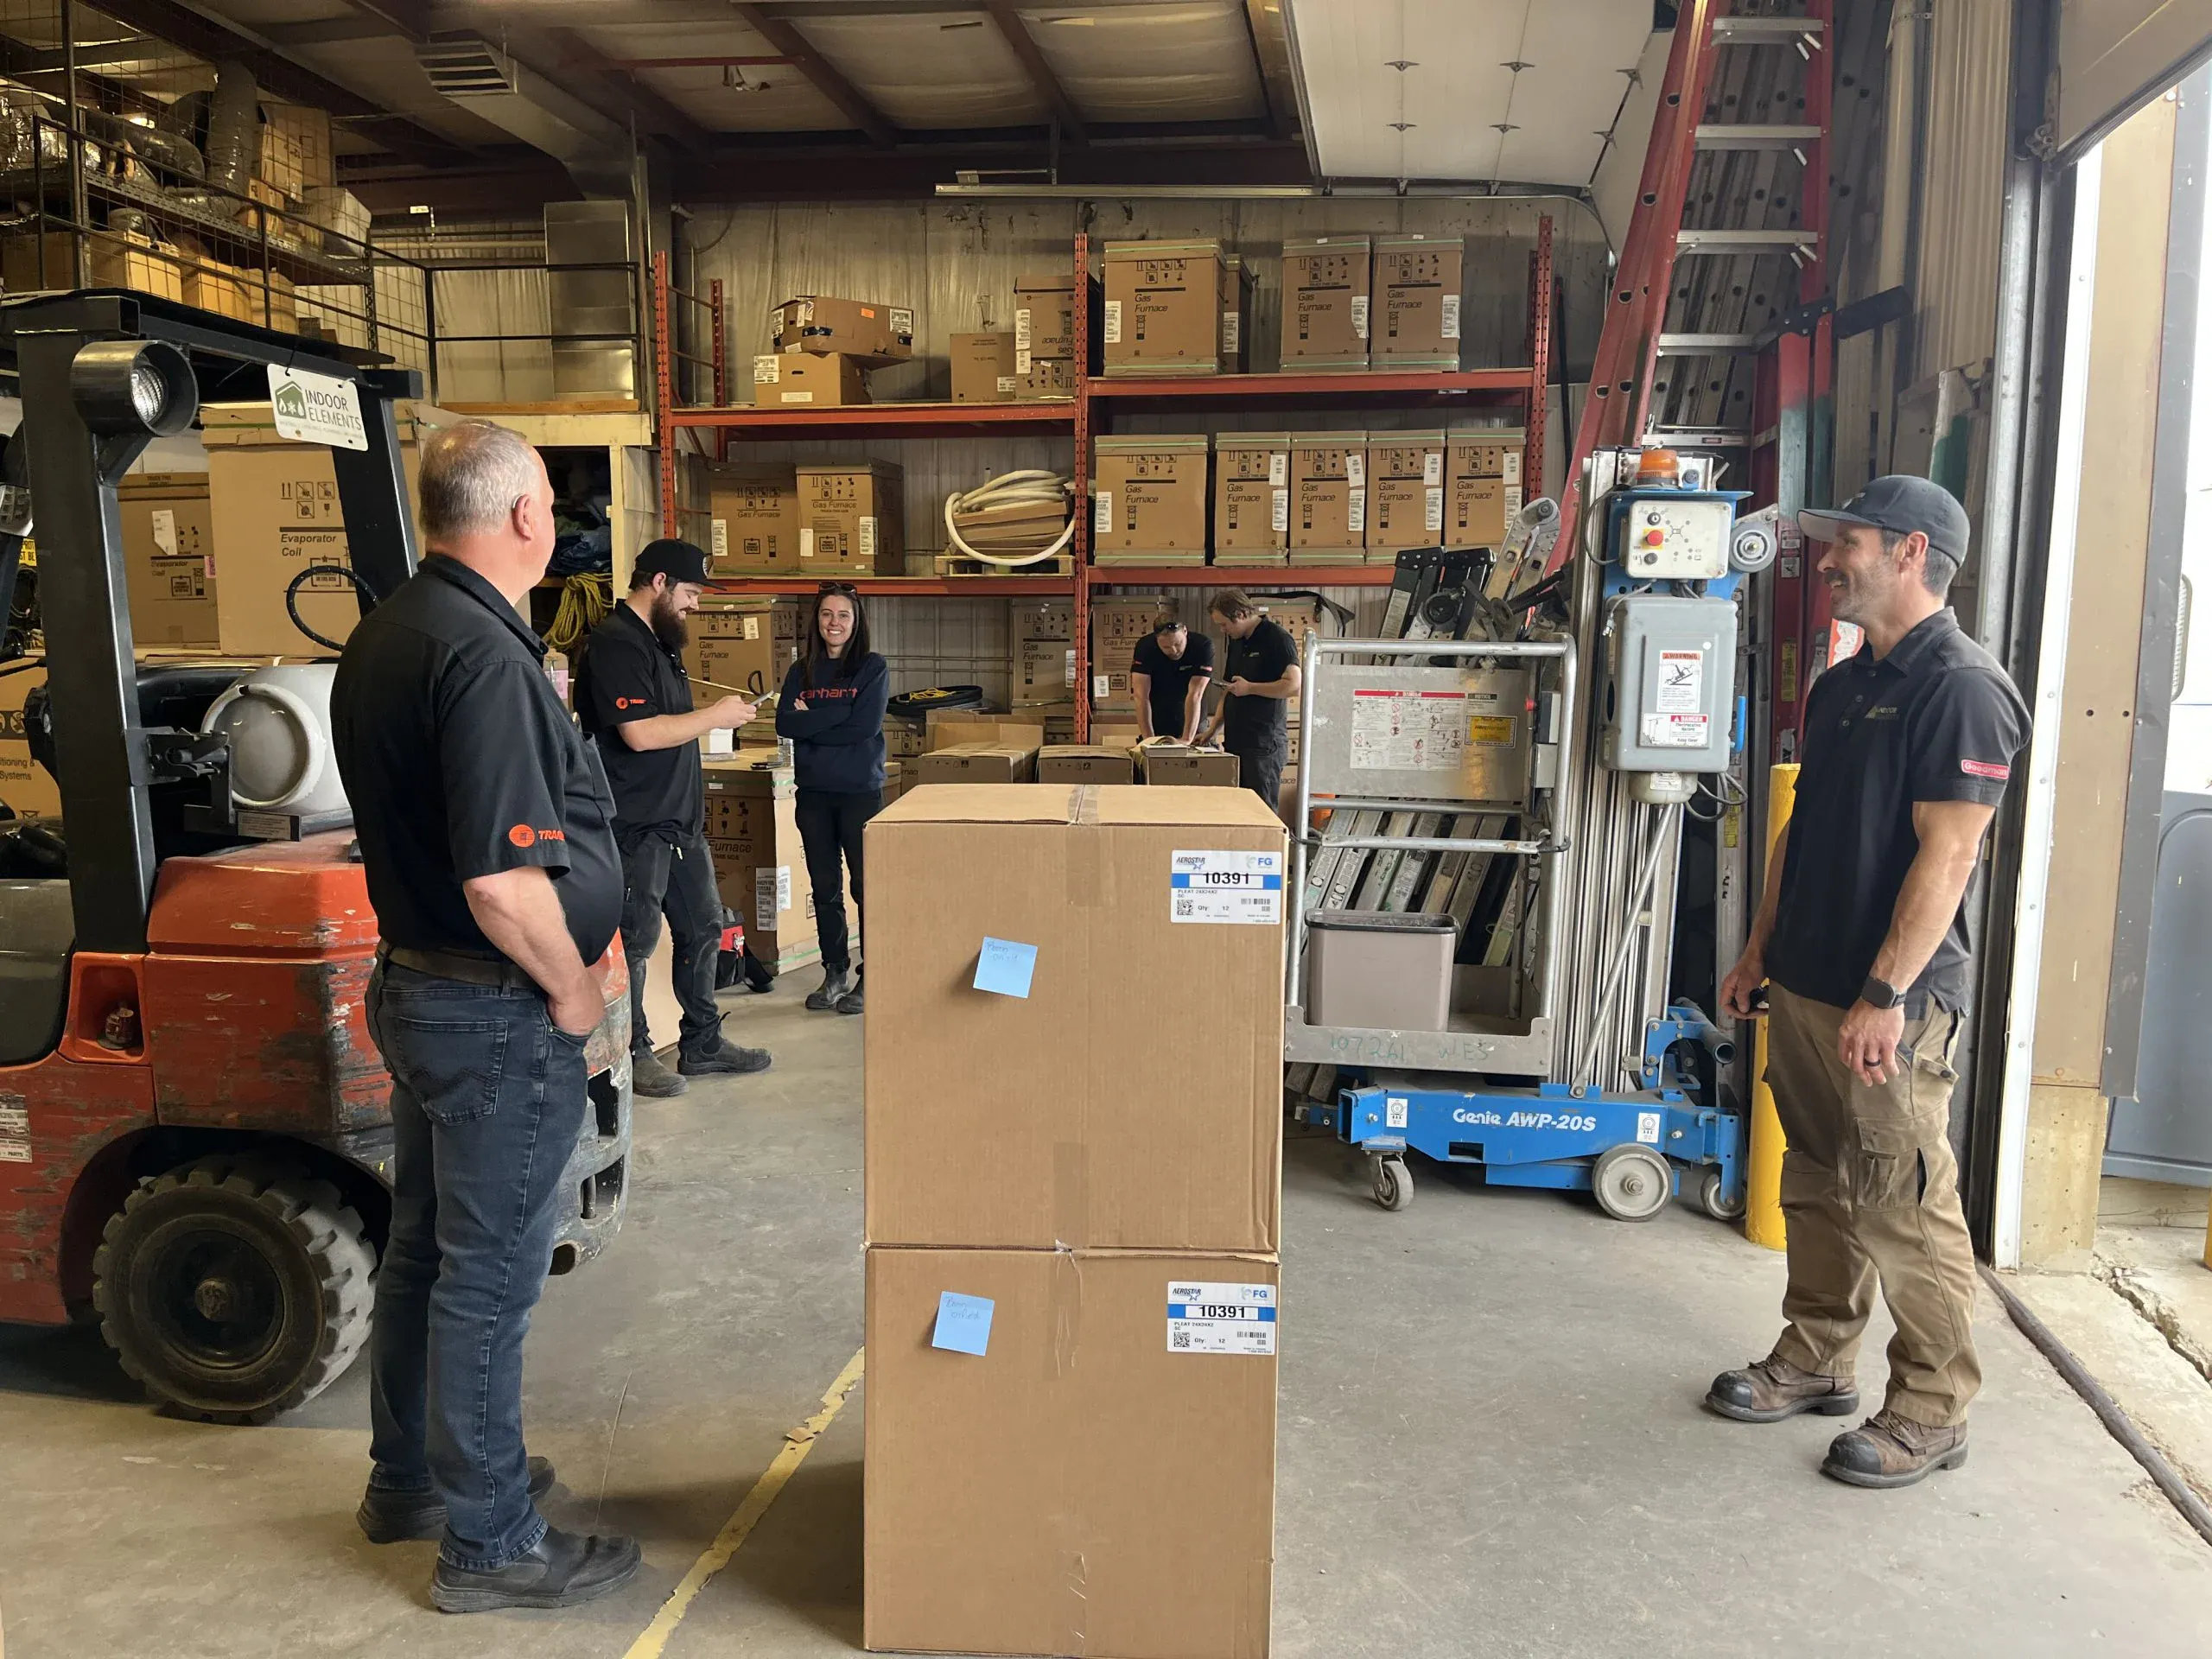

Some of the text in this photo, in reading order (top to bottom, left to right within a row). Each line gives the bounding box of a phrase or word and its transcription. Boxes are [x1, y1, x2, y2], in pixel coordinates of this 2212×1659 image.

[1135, 294, 1152, 302] Gas
[1298, 302, 1332, 311] Furnace
[1042, 336, 1073, 345] Furnace
[305, 389, 348, 412] INDOOR
[308, 407, 362, 431] ELEMENTS
[1126, 495, 1159, 504] Furnace
[281, 534, 336, 544] Evaporator
[282, 547, 302, 556] Coil
[1023, 652, 1054, 661] Furnace
[1964, 762, 2008, 776] Goodman
[0, 769, 32, 782] Systems
[1257, 857, 1273, 866] FG
[1203, 873, 1249, 885] 10391
[1452, 1108, 1597, 1132] Genie AWP-20S
[1253, 1289, 1268, 1299] FG
[1199, 1306, 1245, 1318] 10391
